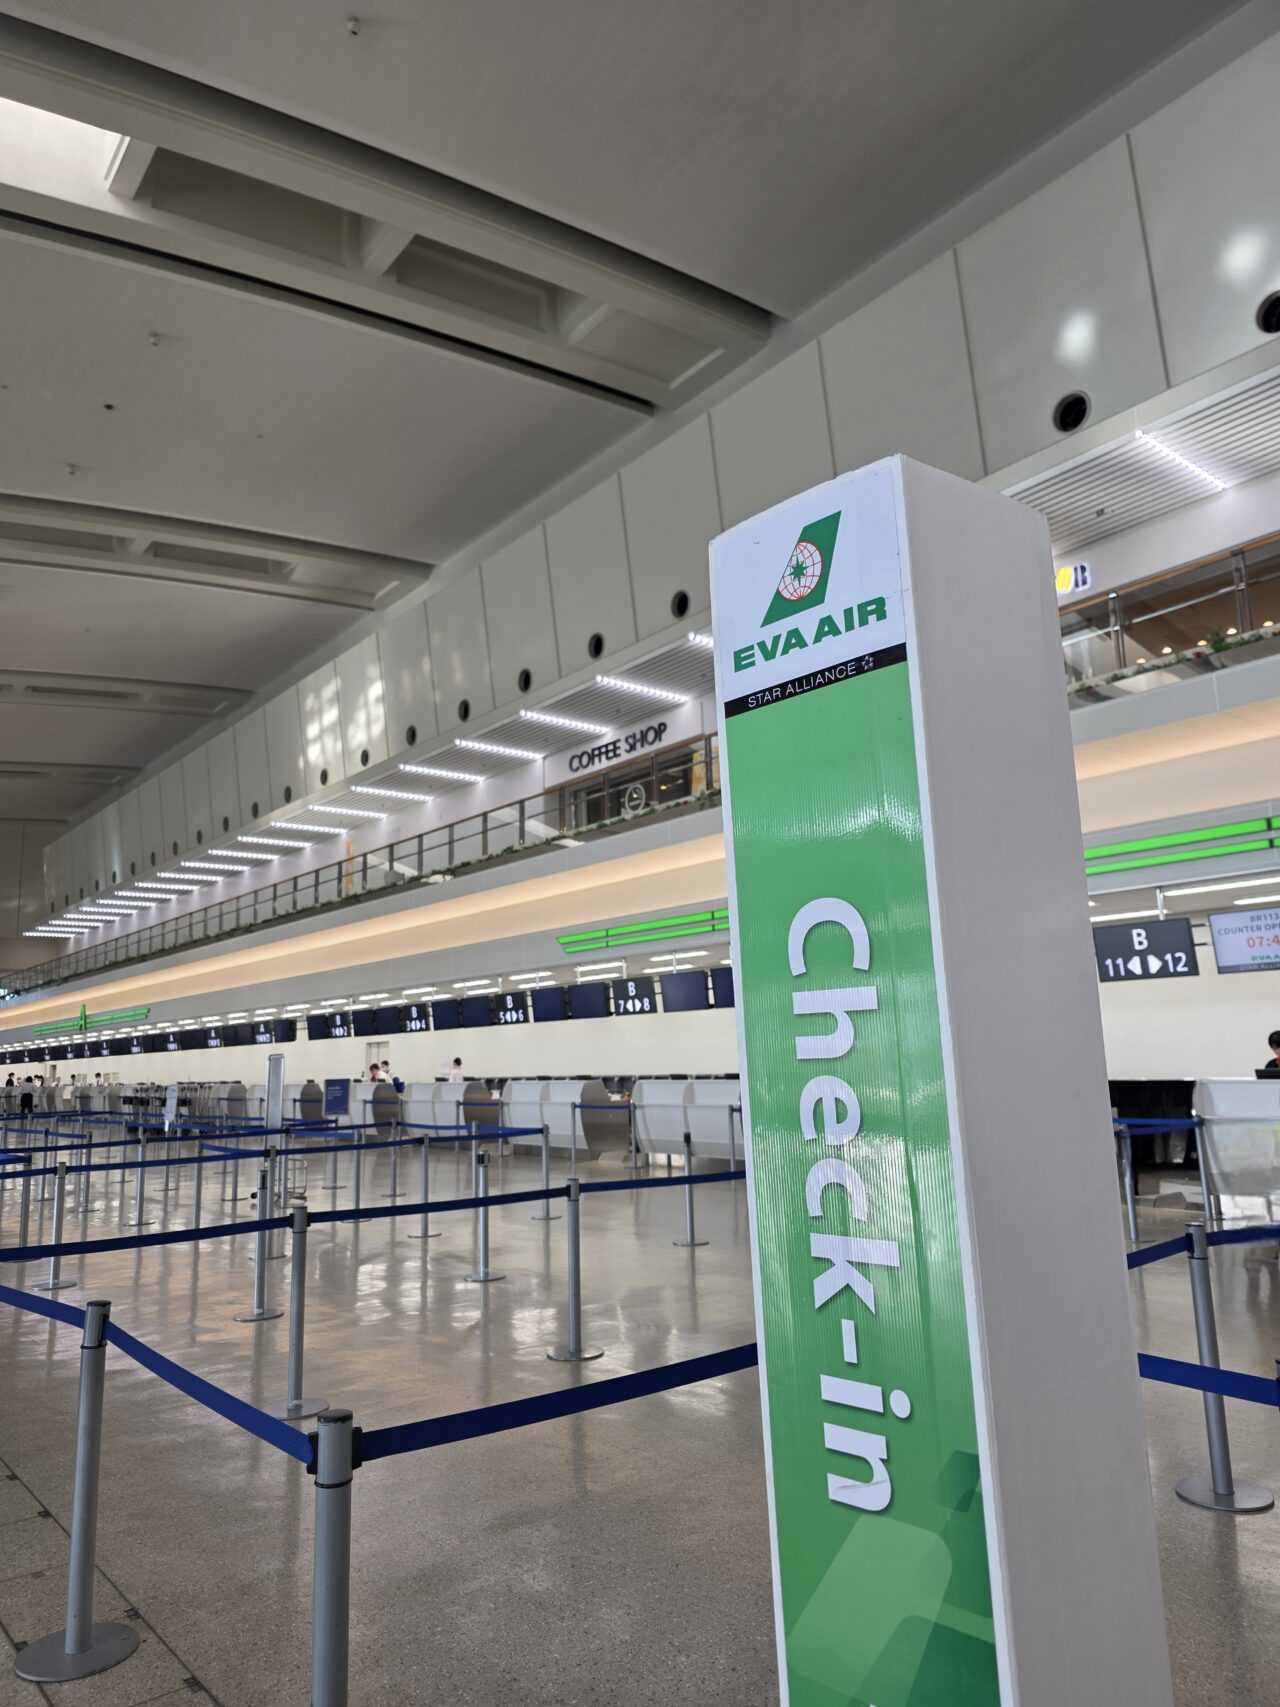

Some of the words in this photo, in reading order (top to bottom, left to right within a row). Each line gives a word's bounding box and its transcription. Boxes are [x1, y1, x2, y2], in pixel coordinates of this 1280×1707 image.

[733, 627, 808, 673] EVA
[812, 596, 887, 645] AIR
[748, 687, 783, 708] STAR
[785, 661, 856, 696] ALLIANCE
[569, 739, 622, 772] COFFEE
[624, 722, 667, 753] SHOP
[1131, 928, 1149, 950] B
[1217, 924, 1263, 937] COUNTER
[1105, 957, 1126, 977] 11
[1164, 952, 1190, 973] 12
[627, 981, 636, 996] B
[411, 1006, 418, 1018] B
[506, 995, 513, 1009] B
[618, 1000, 625, 1013] 7
[643, 997, 650, 1011] 8
[787, 897, 912, 1513] Check-in
